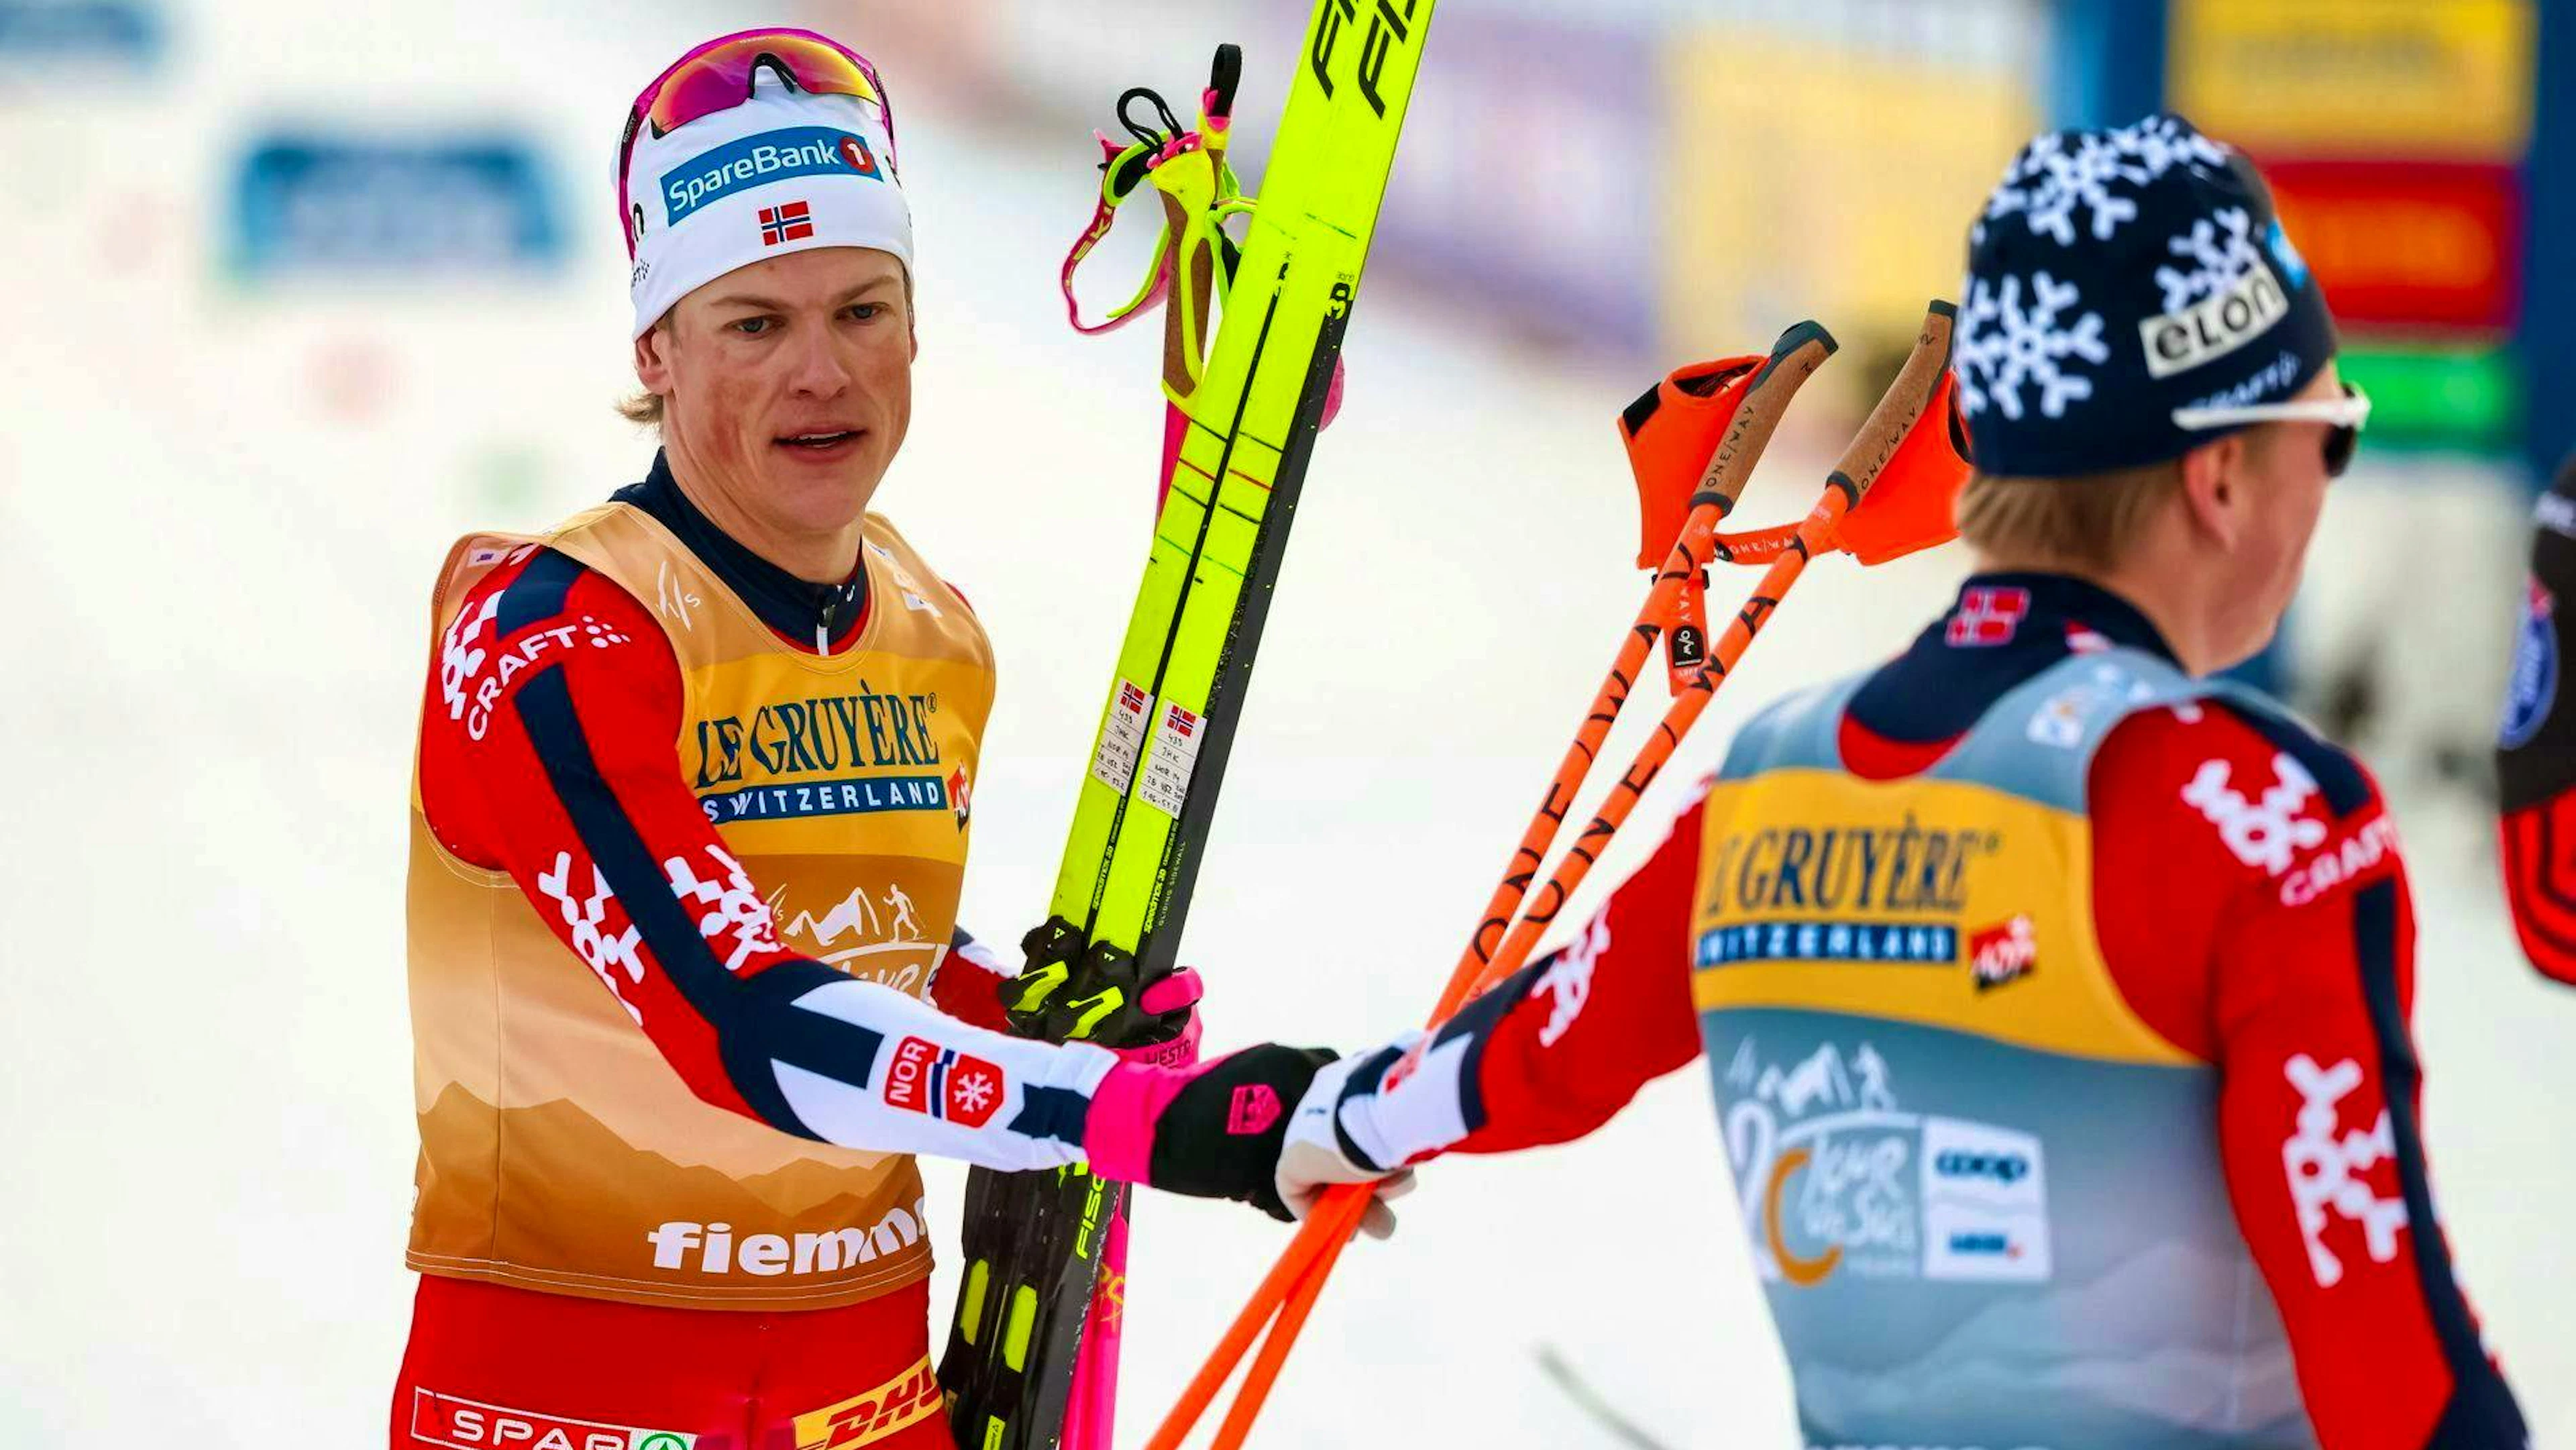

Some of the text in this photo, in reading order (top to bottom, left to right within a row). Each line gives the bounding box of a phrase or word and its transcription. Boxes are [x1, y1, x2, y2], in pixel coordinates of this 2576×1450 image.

[669, 139, 865, 211] SpareBank 1
[468, 625, 578, 741] CRAFT
[694, 715, 745, 789] LE
[703, 780, 940, 823] SWITZERLAND
[890, 1041, 928, 1102] NOR
[826, 1363, 940, 1449] DHL
